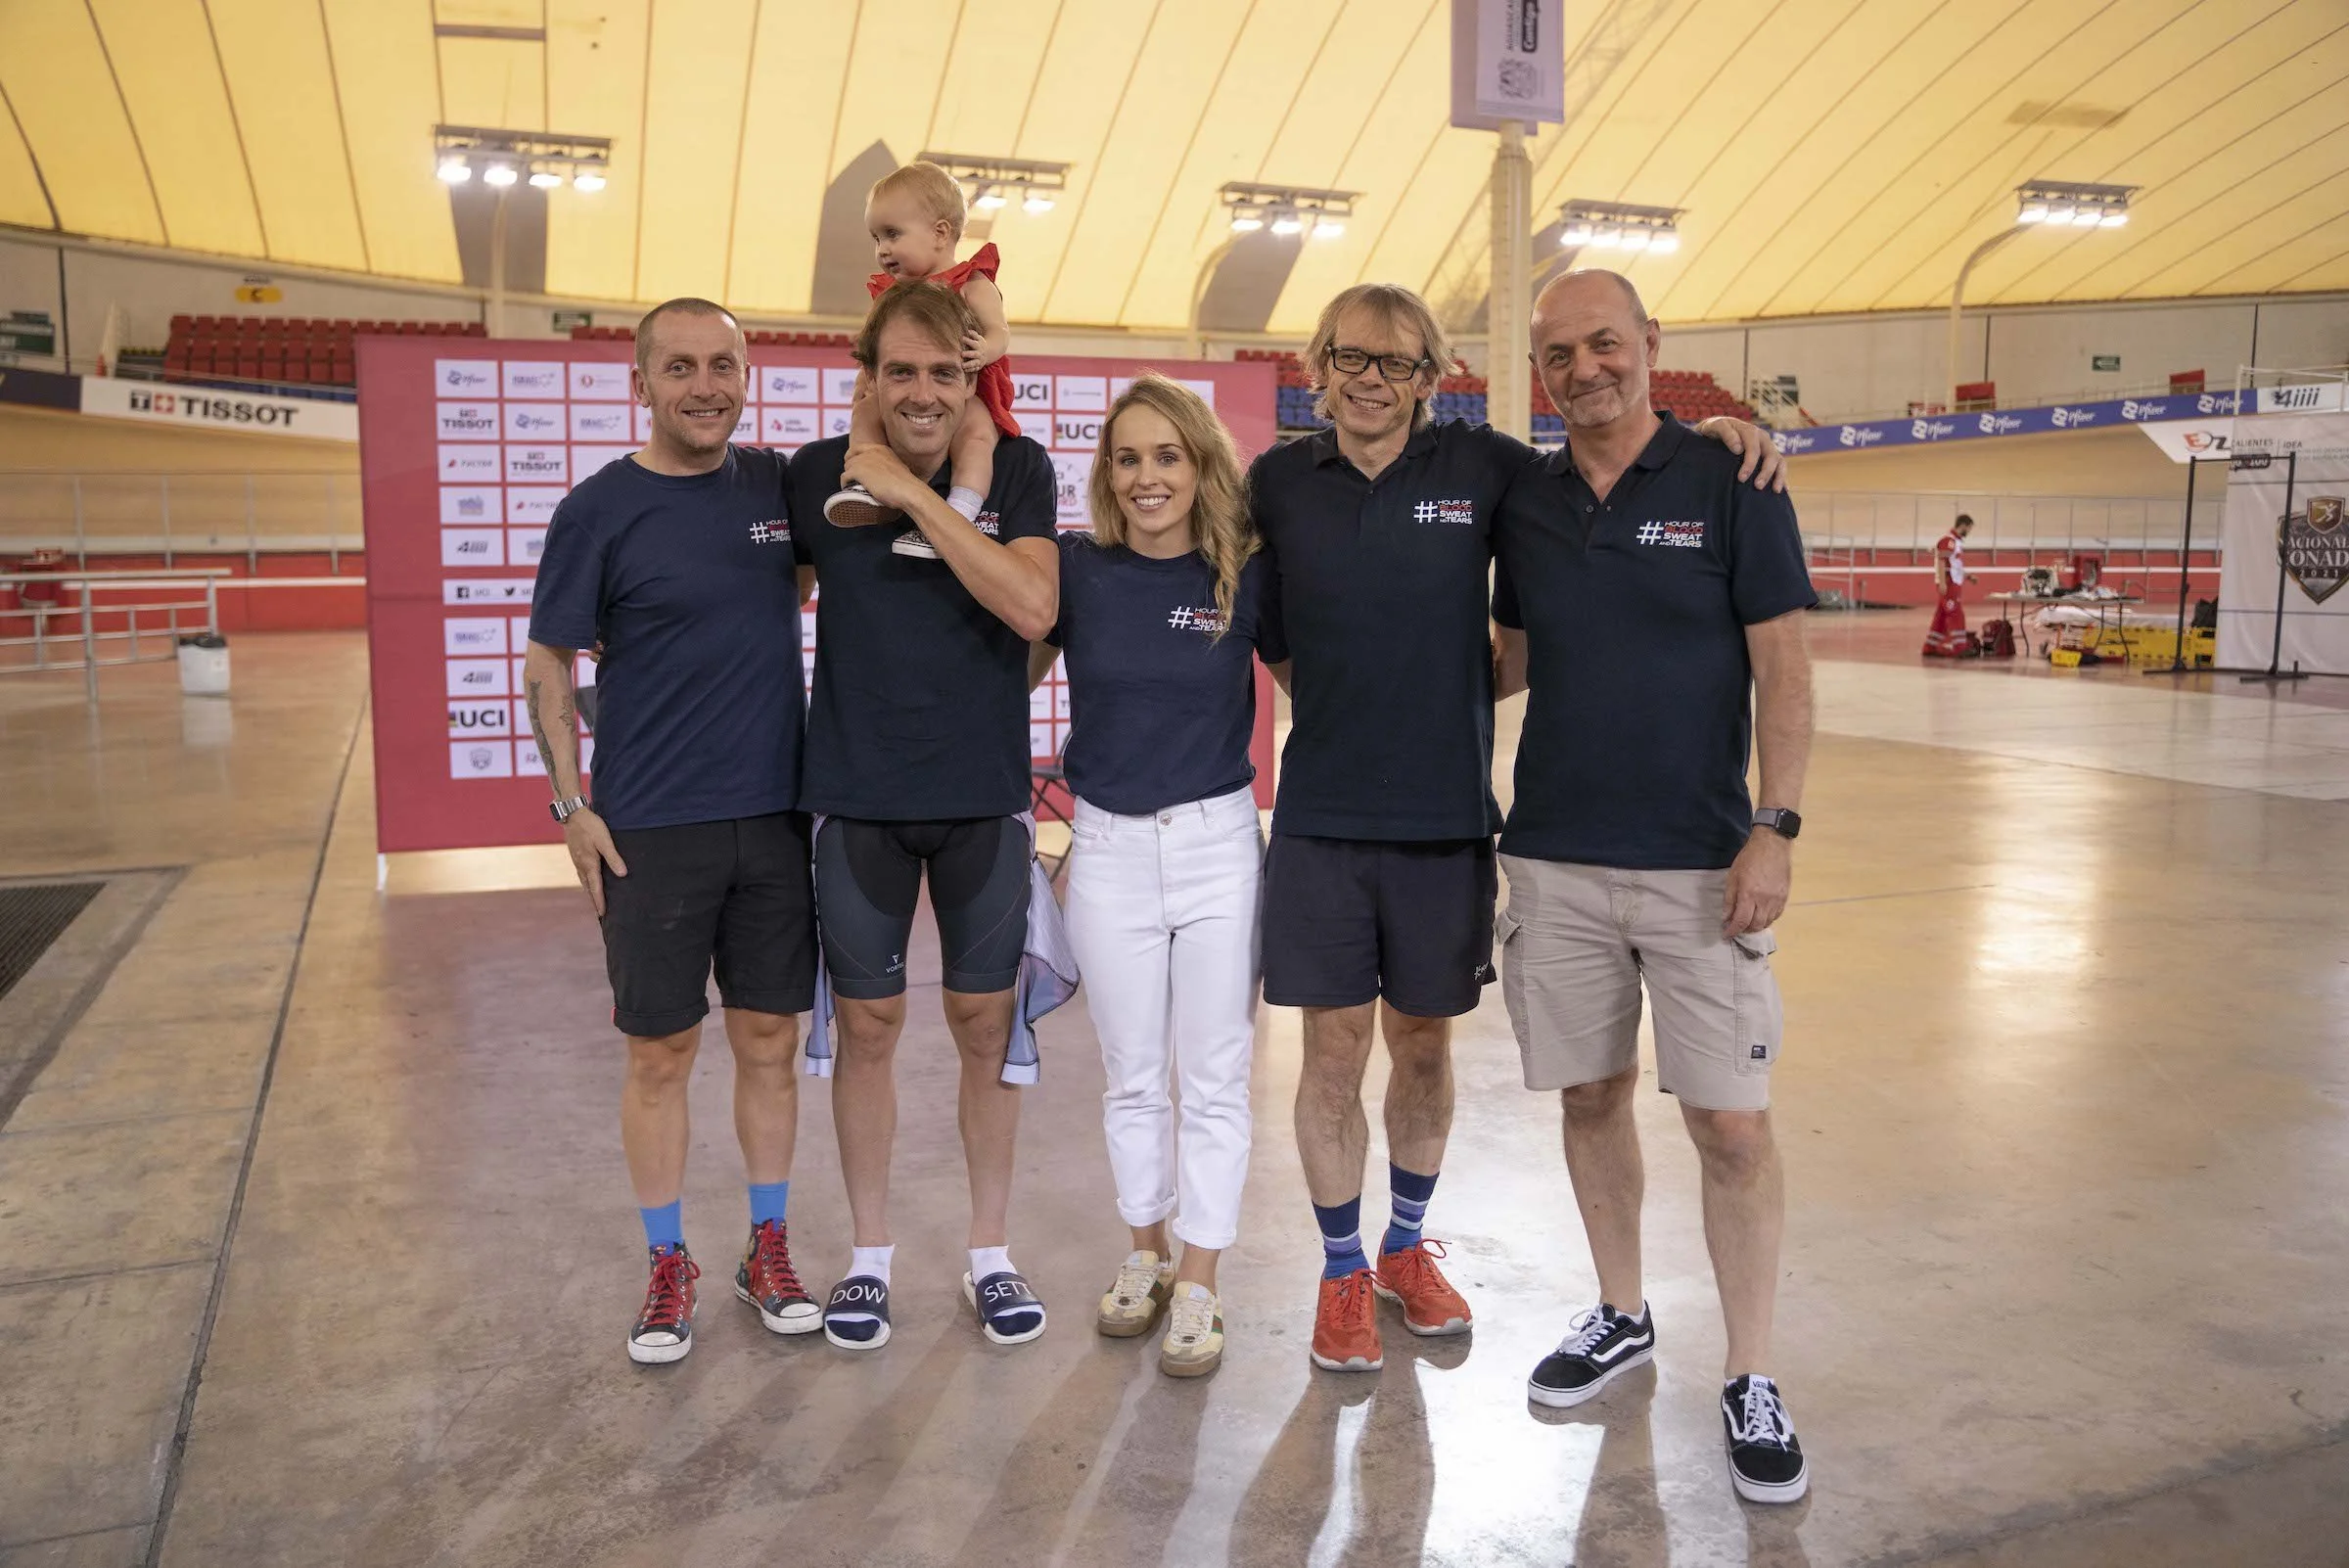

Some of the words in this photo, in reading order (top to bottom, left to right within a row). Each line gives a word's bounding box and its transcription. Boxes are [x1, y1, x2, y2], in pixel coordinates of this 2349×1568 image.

[180, 396, 299, 426] TISSOT
[2215, 395, 2243, 414] Pfizr
[442, 418, 494, 429] TISSOT
[511, 461, 563, 470] TISSOT
[2279, 549, 2349, 568] ONAD
[459, 710, 504, 727] UCI
[830, 1284, 886, 1305] DOW
